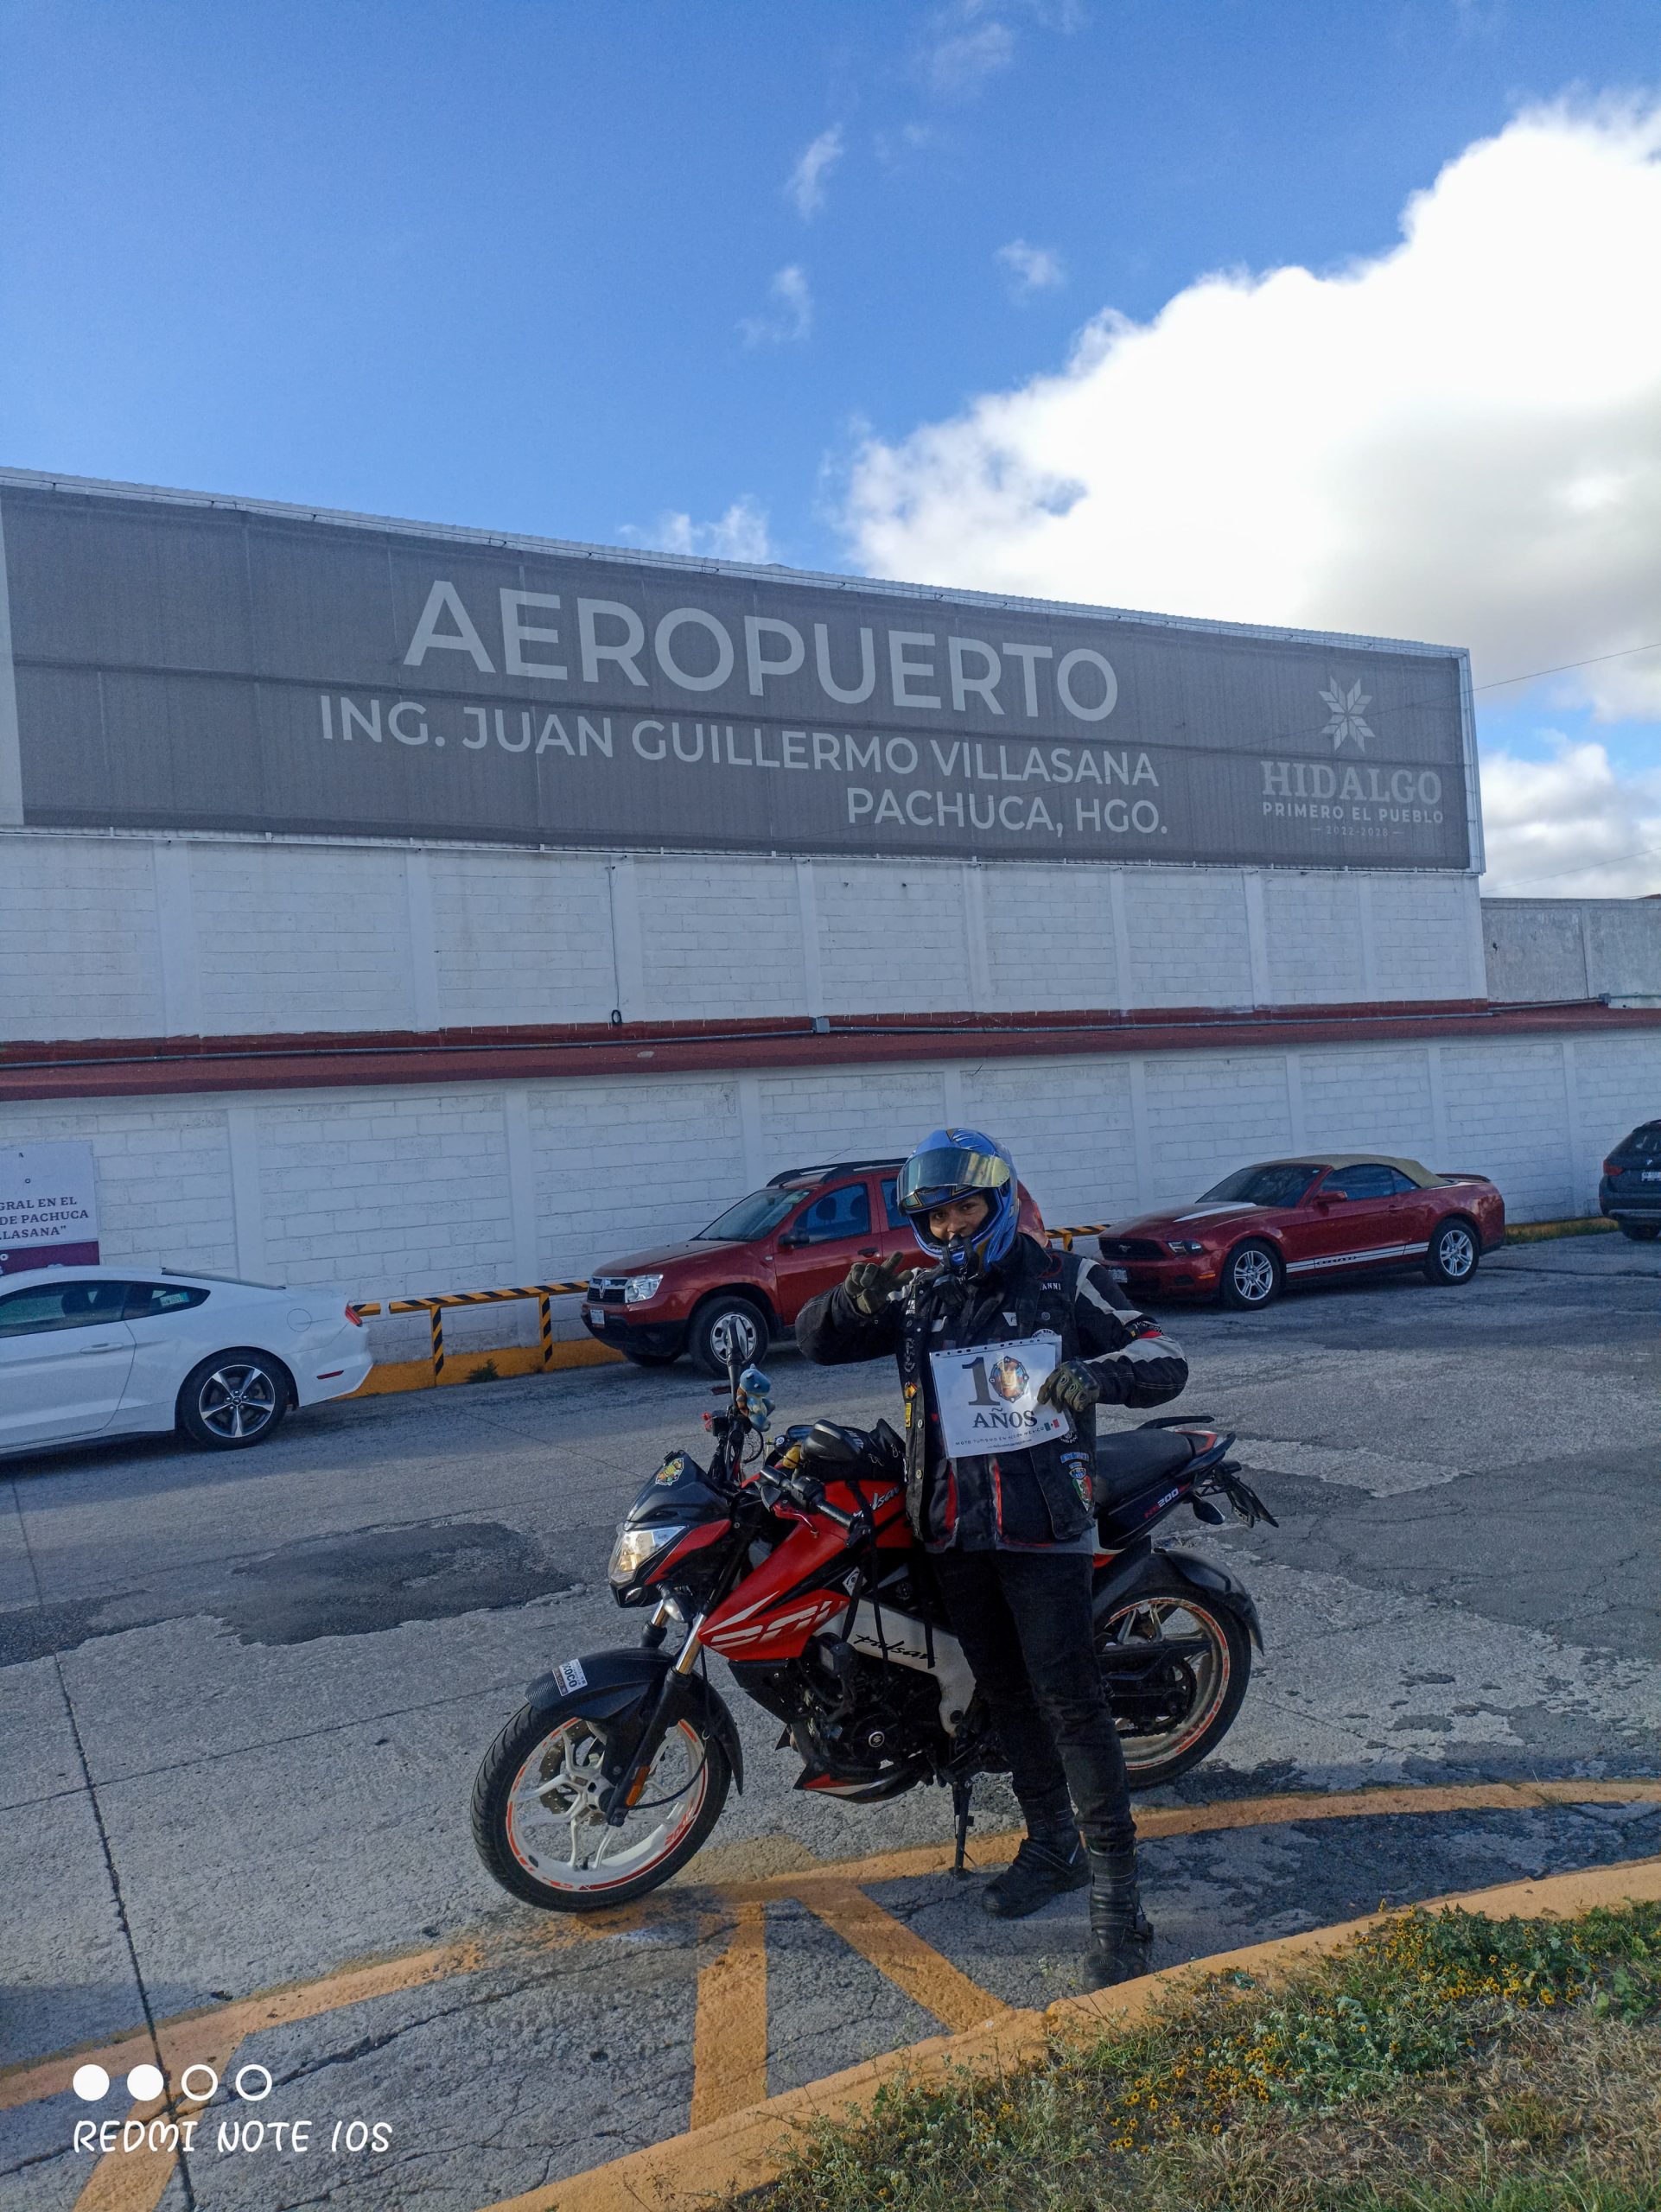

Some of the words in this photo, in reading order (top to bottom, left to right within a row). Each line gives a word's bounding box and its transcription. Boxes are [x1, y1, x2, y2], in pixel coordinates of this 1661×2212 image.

[404, 580, 1118, 721] AEROPUERTO
[320, 695, 446, 747] ING.
[461, 706, 613, 758] JUAN
[631, 720, 919, 774] GUILLERMO
[930, 739, 1160, 787] VILLASANA
[1260, 760, 1442, 804] HIDALGO
[847, 787, 1064, 837] PACHUCA,
[1075, 798, 1168, 835] HGO.
[1262, 801, 1344, 820] PRIMERO
[1352, 807, 1371, 821] EL
[1378, 808, 1443, 824] PUEBLO
[38, 1198, 56, 1208] EN
[60, 1197, 77, 1206] EL
[0, 1215, 18, 1226] DE
[21, 1209, 89, 1224] PACHUCA
[0, 1225, 67, 1240] LASANA"
[971, 1408, 1038, 1428] AÑOS
